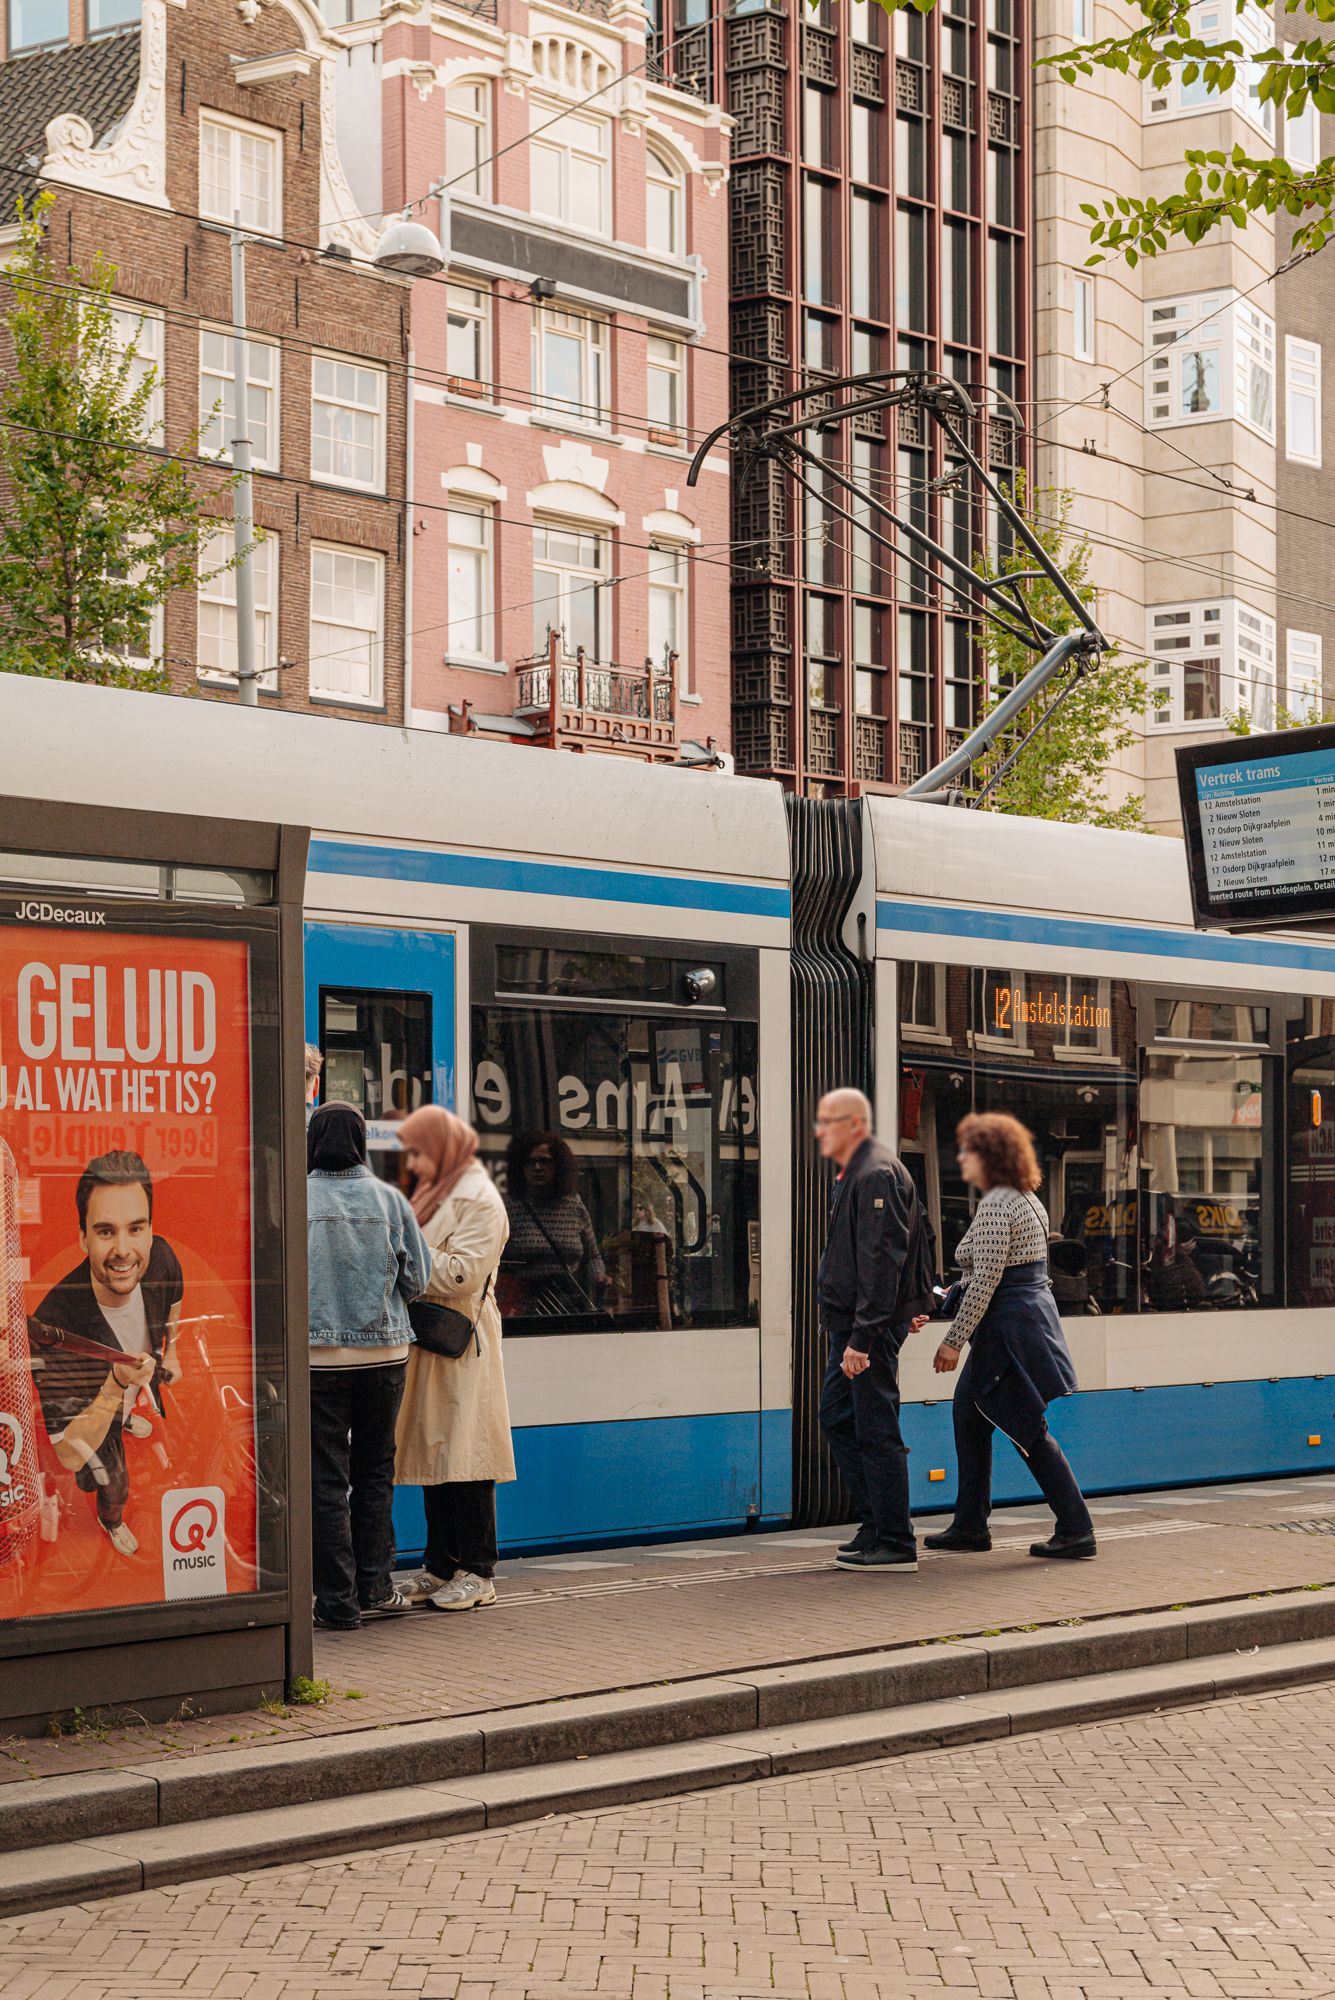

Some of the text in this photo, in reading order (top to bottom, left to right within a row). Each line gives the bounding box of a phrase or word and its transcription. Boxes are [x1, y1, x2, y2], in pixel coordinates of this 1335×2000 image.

[1199, 765, 1280, 788] Vertrek trams
[1204, 801, 1212, 810] 12
[1215, 796, 1262, 808] Amstelstation
[1208, 828, 1215, 836] 17
[1218, 825, 1242, 835] Osdorp
[1243, 818, 1291, 832] Dijkgraafplein
[1318, 814, 1323, 822] 4
[1210, 814, 1214, 822] 2
[1216, 812, 1238, 822] Nieuw
[1240, 809, 1261, 819] Sloten
[1212, 840, 1216, 848] 2
[1220, 838, 1240, 848] Nieuw
[1242, 836, 1264, 846] Sloten
[1316, 828, 1324, 836] 10
[1210, 853, 1218, 862] 12
[1220, 848, 1267, 860] Amstelstation
[1318, 841, 1326, 849] 11
[1212, 867, 1220, 875] 17
[1222, 864, 1246, 874] Osdorp
[1247, 858, 1295, 872] Dijkgraafplein
[1318, 854, 1327, 863] 12
[1217, 879, 1221, 888] 2
[1223, 878, 1244, 887] Nieuw
[1246, 876, 1268, 884] Sloten
[1320, 868, 1328, 876] 17
[1209, 891, 1234, 902] iverted
[1234, 889, 1253, 899] route
[1254, 888, 1271, 897] from
[1272, 882, 1313, 895] Leidseplein.
[15, 902, 106, 925] JCDecaux
[18, 962, 217, 1065] GELUID
[995, 988, 1110, 1029] 12 Amstelstation
[14, 1066, 51, 1111] AL
[54, 1066, 117, 1112] WAT
[122, 1068, 171, 1114] HET
[176, 1070, 217, 1114] IS?
